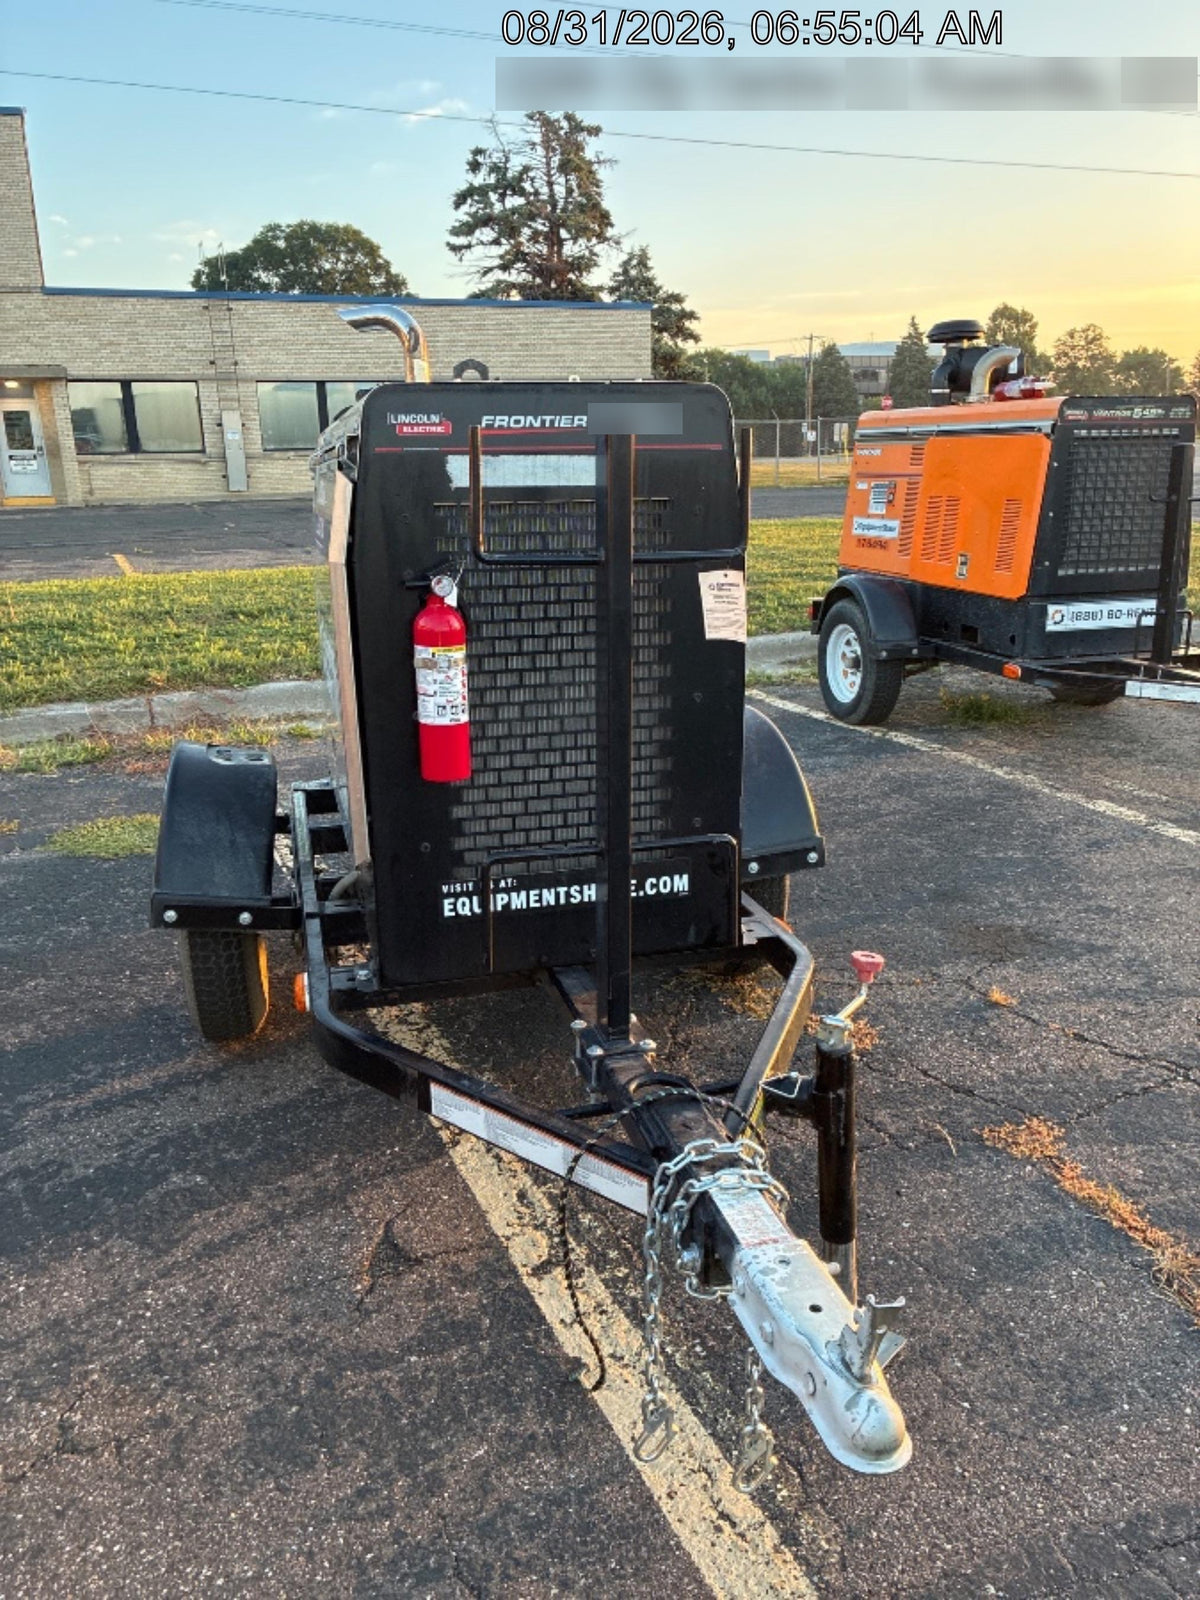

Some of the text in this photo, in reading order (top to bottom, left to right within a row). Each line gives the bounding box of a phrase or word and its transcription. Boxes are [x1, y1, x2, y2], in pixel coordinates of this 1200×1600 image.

[390, 413, 440, 424] LINCOLN
[481, 415, 588, 428] FRONTIER
[402, 425, 446, 433] ELECTRIC
[442, 881, 474, 894] VISIT
[499, 877, 517, 888] AT:
